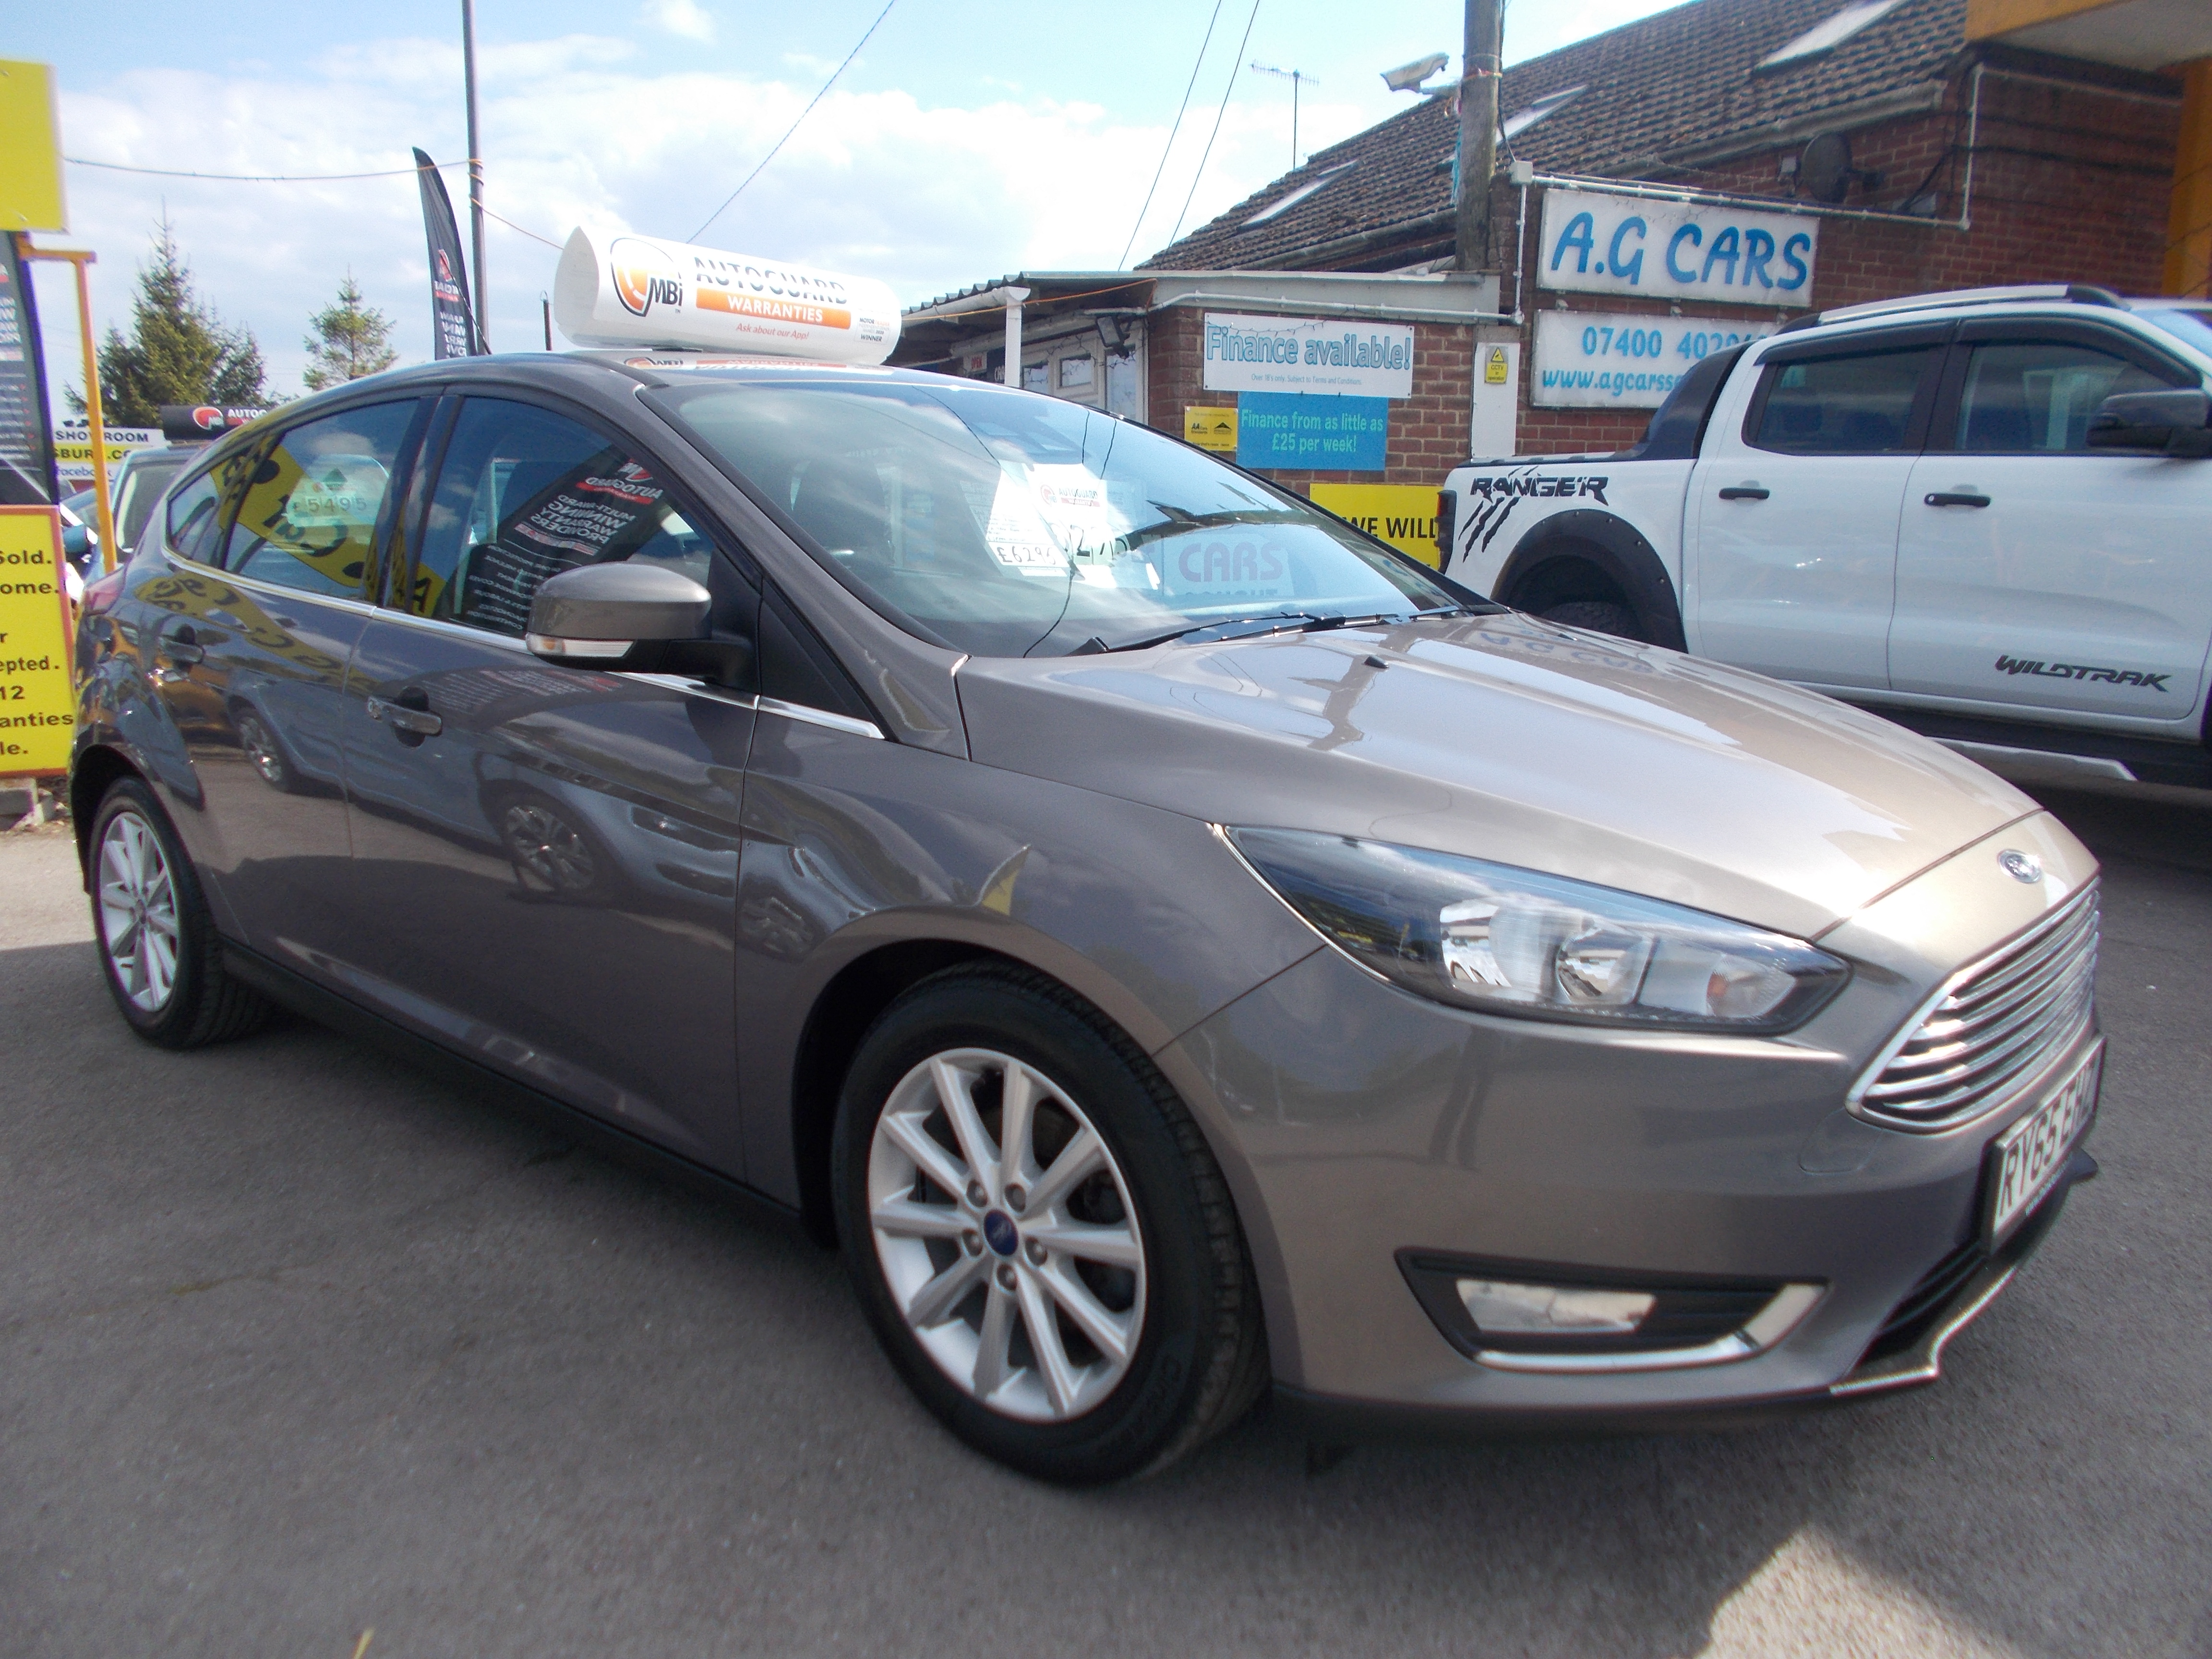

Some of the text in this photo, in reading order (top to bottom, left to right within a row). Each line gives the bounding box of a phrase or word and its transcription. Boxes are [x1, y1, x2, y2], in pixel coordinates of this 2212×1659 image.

[1551, 211, 1811, 290] A.G CARS
[727, 295, 823, 322] WARRANTIES
[736, 323, 751, 332] Ask
[753, 325, 776, 335] about
[792, 330, 809, 340] App!
[1583, 326, 1662, 358] 07400
[1206, 325, 1411, 370] Finance available!
[1287, 375, 1304, 383] Subject
[1241, 409, 1383, 431] Finance from as little as
[56, 431, 149, 442] SHOROOM
[1272, 433, 1357, 455] £25 per week!
[1470, 477, 1609, 506] RANGER
[1385, 517, 1436, 539] WILL
[1178, 541, 1283, 582] CARS
[1995, 655, 2171, 692] WILDTRAK
